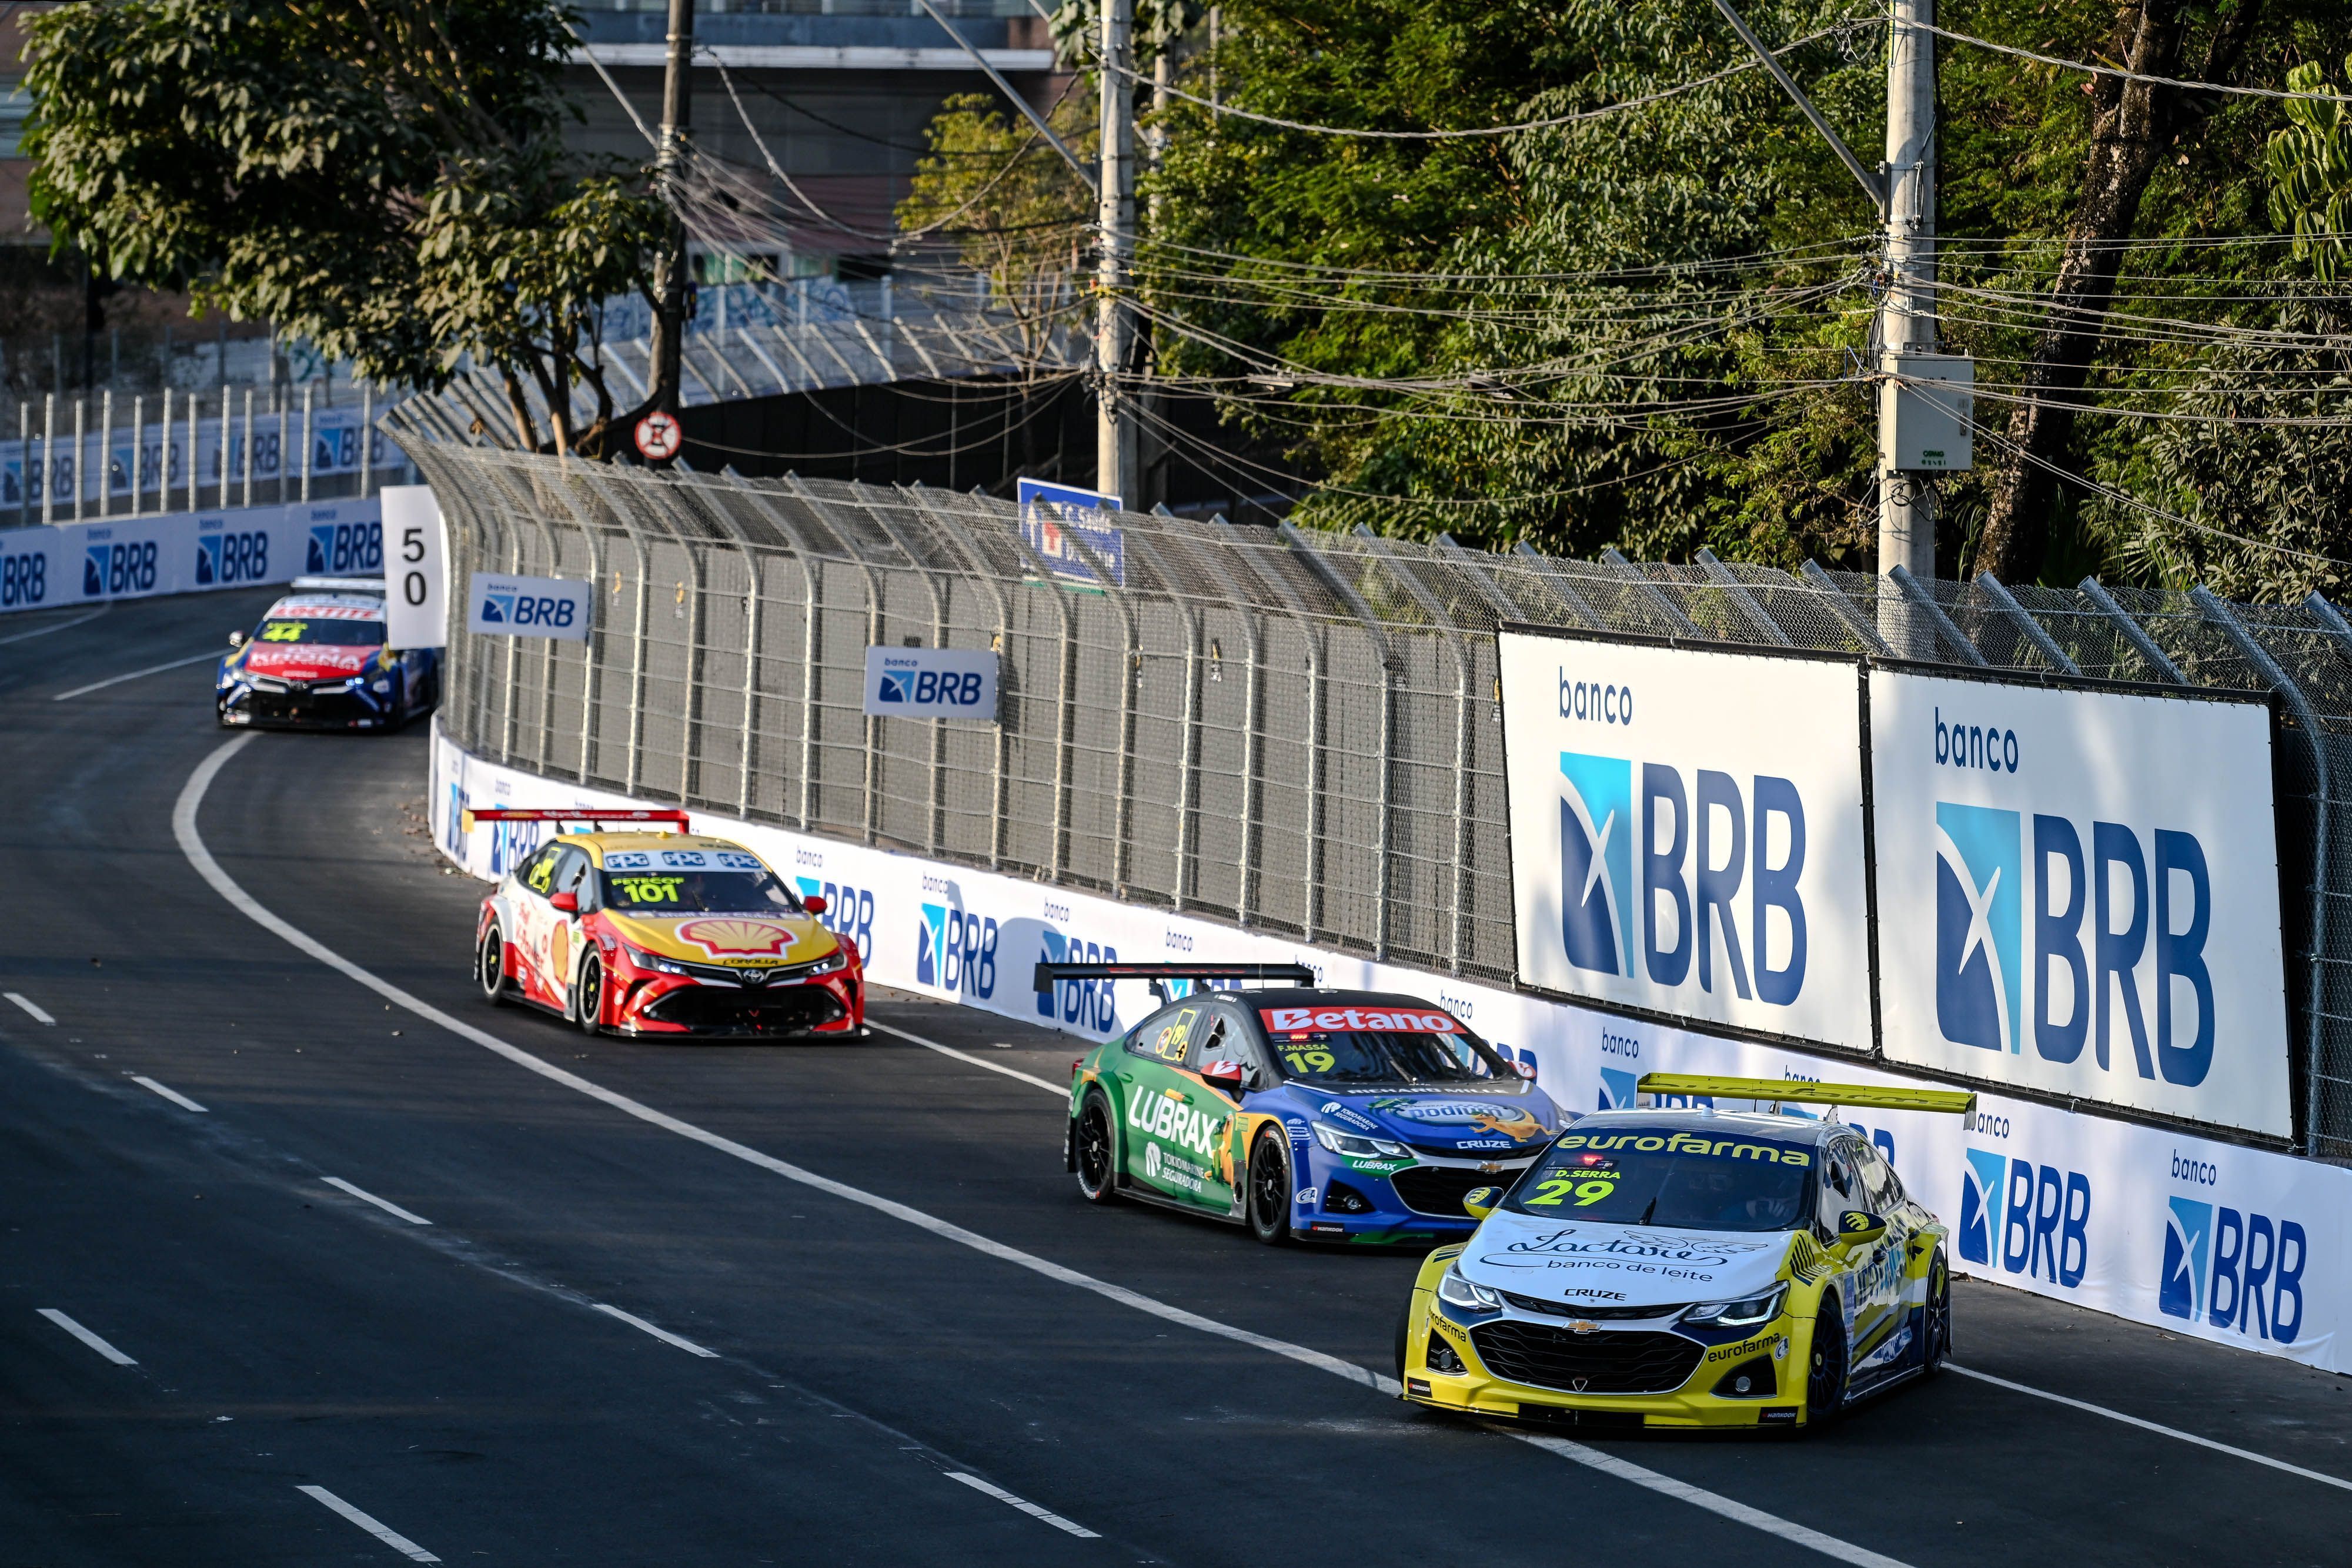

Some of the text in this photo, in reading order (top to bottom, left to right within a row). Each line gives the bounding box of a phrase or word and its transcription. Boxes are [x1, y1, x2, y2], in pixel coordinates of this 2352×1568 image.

[221, 530, 269, 583] BRB
[333, 521, 383, 571] BRB
[2, 551, 46, 607] BRB
[109, 540, 158, 593] BRB
[514, 596, 575, 627] BRB
[884, 658, 918, 667] banco
[914, 671, 982, 706] BRB
[1559, 666, 1632, 726] banco
[1935, 706, 2019, 774] banco
[796, 844, 823, 868] banco
[612, 877, 685, 885] PETECOF
[623, 884, 680, 902] 101
[923, 870, 948, 895] banco
[1642, 762, 1808, 1006] BRB
[1044, 897, 1070, 922] banco
[944, 909, 998, 999] BRB
[1165, 925, 1193, 952] banco
[2033, 813, 2216, 1087] BRB
[1064, 938, 1117, 1034] BRB
[1441, 989, 1473, 1019] banco
[1271, 1008, 1454, 1032] Betano
[1601, 1027, 1639, 1059] banco
[1284, 1051, 1336, 1074] 19
[1128, 1085, 1220, 1159] LUBRAX
[1334, 1111, 1370, 1131] SEGURADORA
[1456, 1139, 1512, 1149] CRUZE
[1556, 1132, 1810, 1168] eurofarma
[1352, 1160, 1398, 1172] LUBRAX
[1555, 1170, 1621, 1179] D.SERRA
[2171, 1148, 2217, 1186] banco
[1523, 1179, 1615, 1206] 29
[2003, 1158, 2091, 1289] BRB
[1547, 1259, 1713, 1282] banco de leite
[2208, 1206, 2307, 1345] BRB
[1565, 1289, 1627, 1302] CRUZE
[1708, 1332, 1780, 1363] eurofarma
